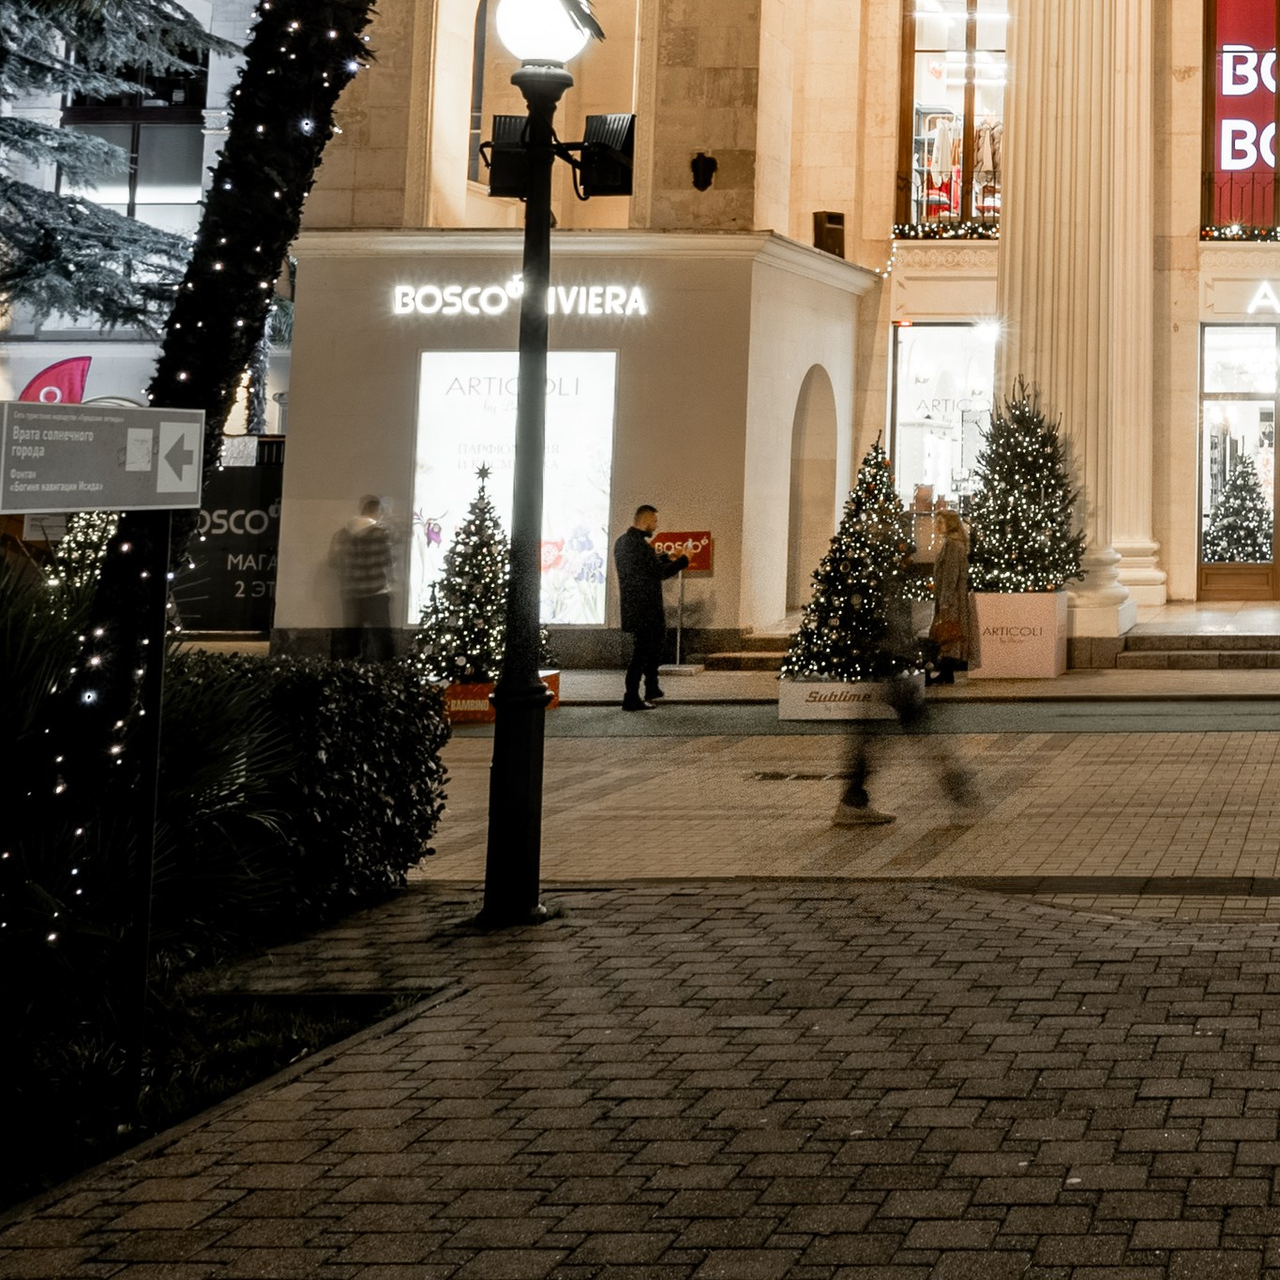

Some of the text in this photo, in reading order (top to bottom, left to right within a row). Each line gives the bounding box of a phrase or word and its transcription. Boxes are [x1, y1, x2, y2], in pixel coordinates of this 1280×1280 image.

[394, 285, 647, 316] BOSCO IVIERA
[12, 426, 94, 443] Врата солнечного
[11, 445, 45, 459] города
[10, 468, 36, 479] Фонтан
[10, 480, 40, 492] «Богиня
[198, 509, 269, 534] OSCO
[235, 580, 245, 597] 2
[982, 626, 1043, 637] ARTICOLI
[805, 690, 871, 703] Sublime
[450, 699, 489, 711] BAMBINO
